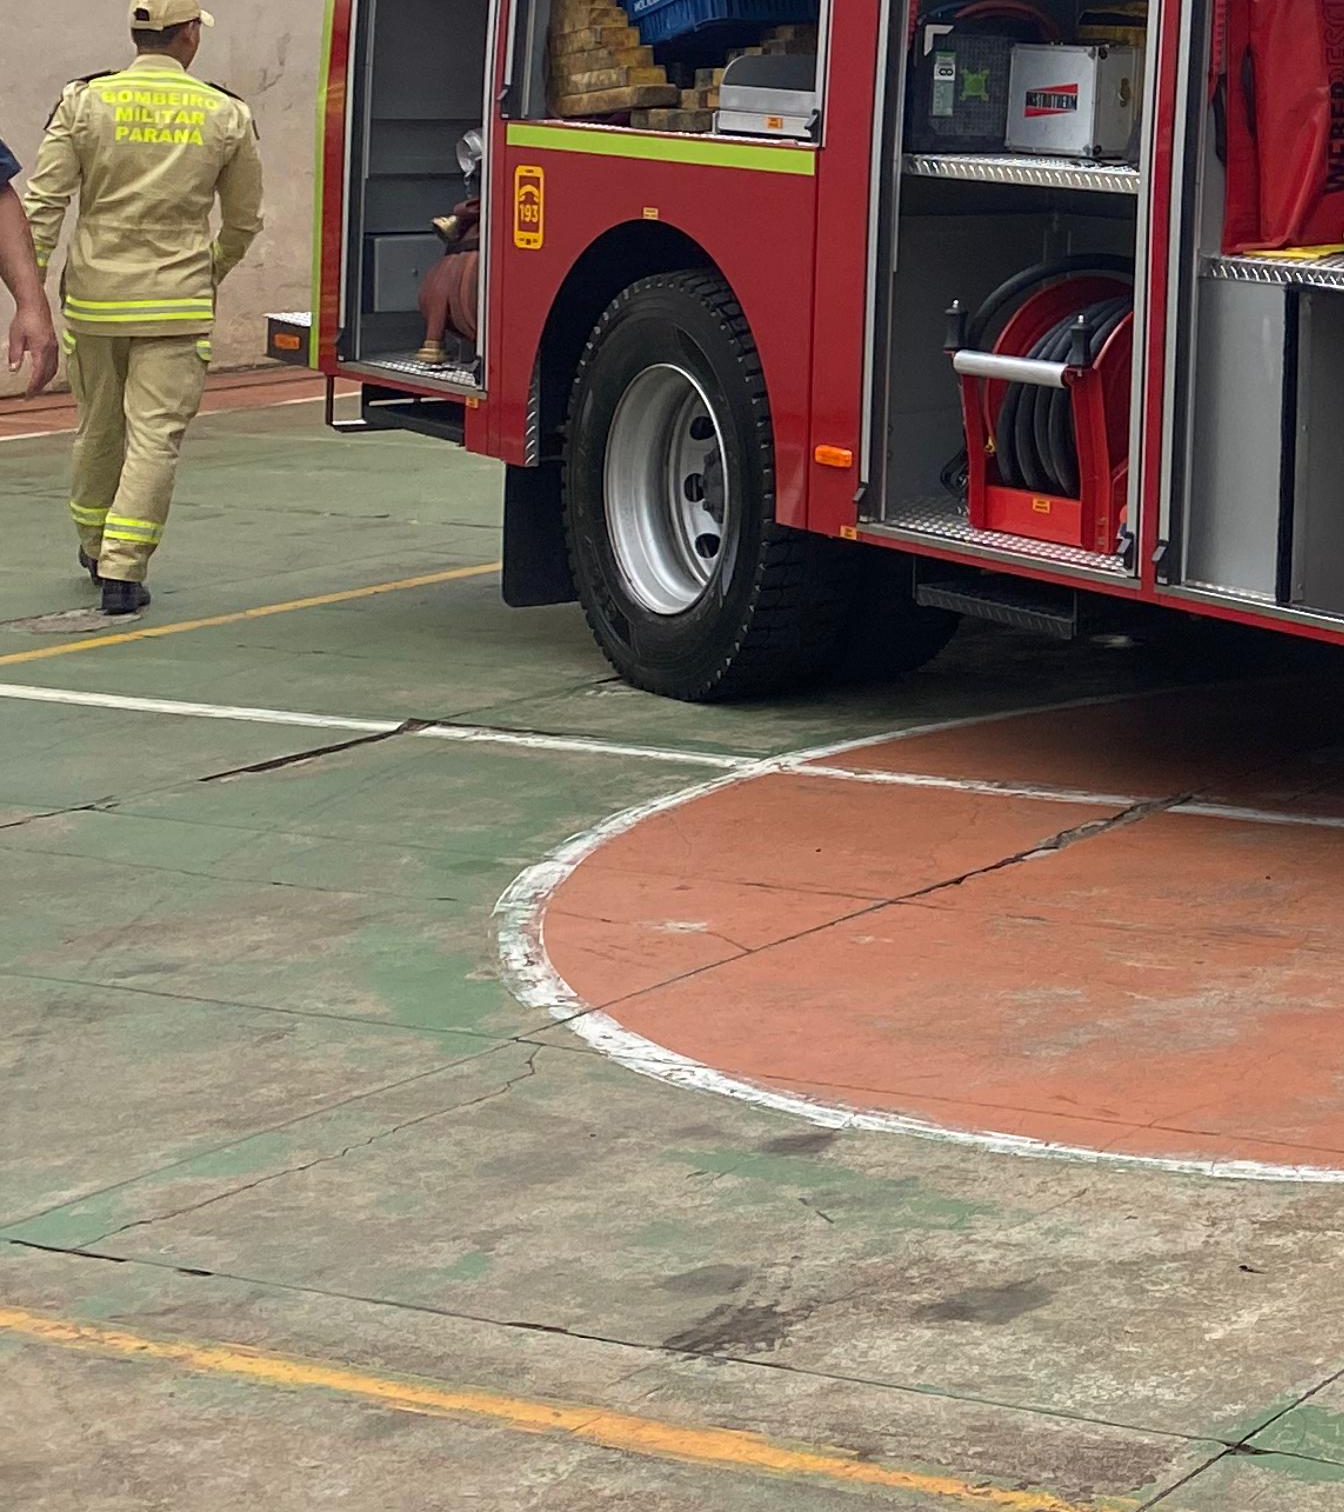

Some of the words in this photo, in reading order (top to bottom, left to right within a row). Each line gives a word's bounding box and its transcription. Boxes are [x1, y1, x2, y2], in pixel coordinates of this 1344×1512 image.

[101, 90, 219, 110] BOMBEIRO
[115, 106, 205, 125] MILITAR
[519, 204, 538, 223] 193
